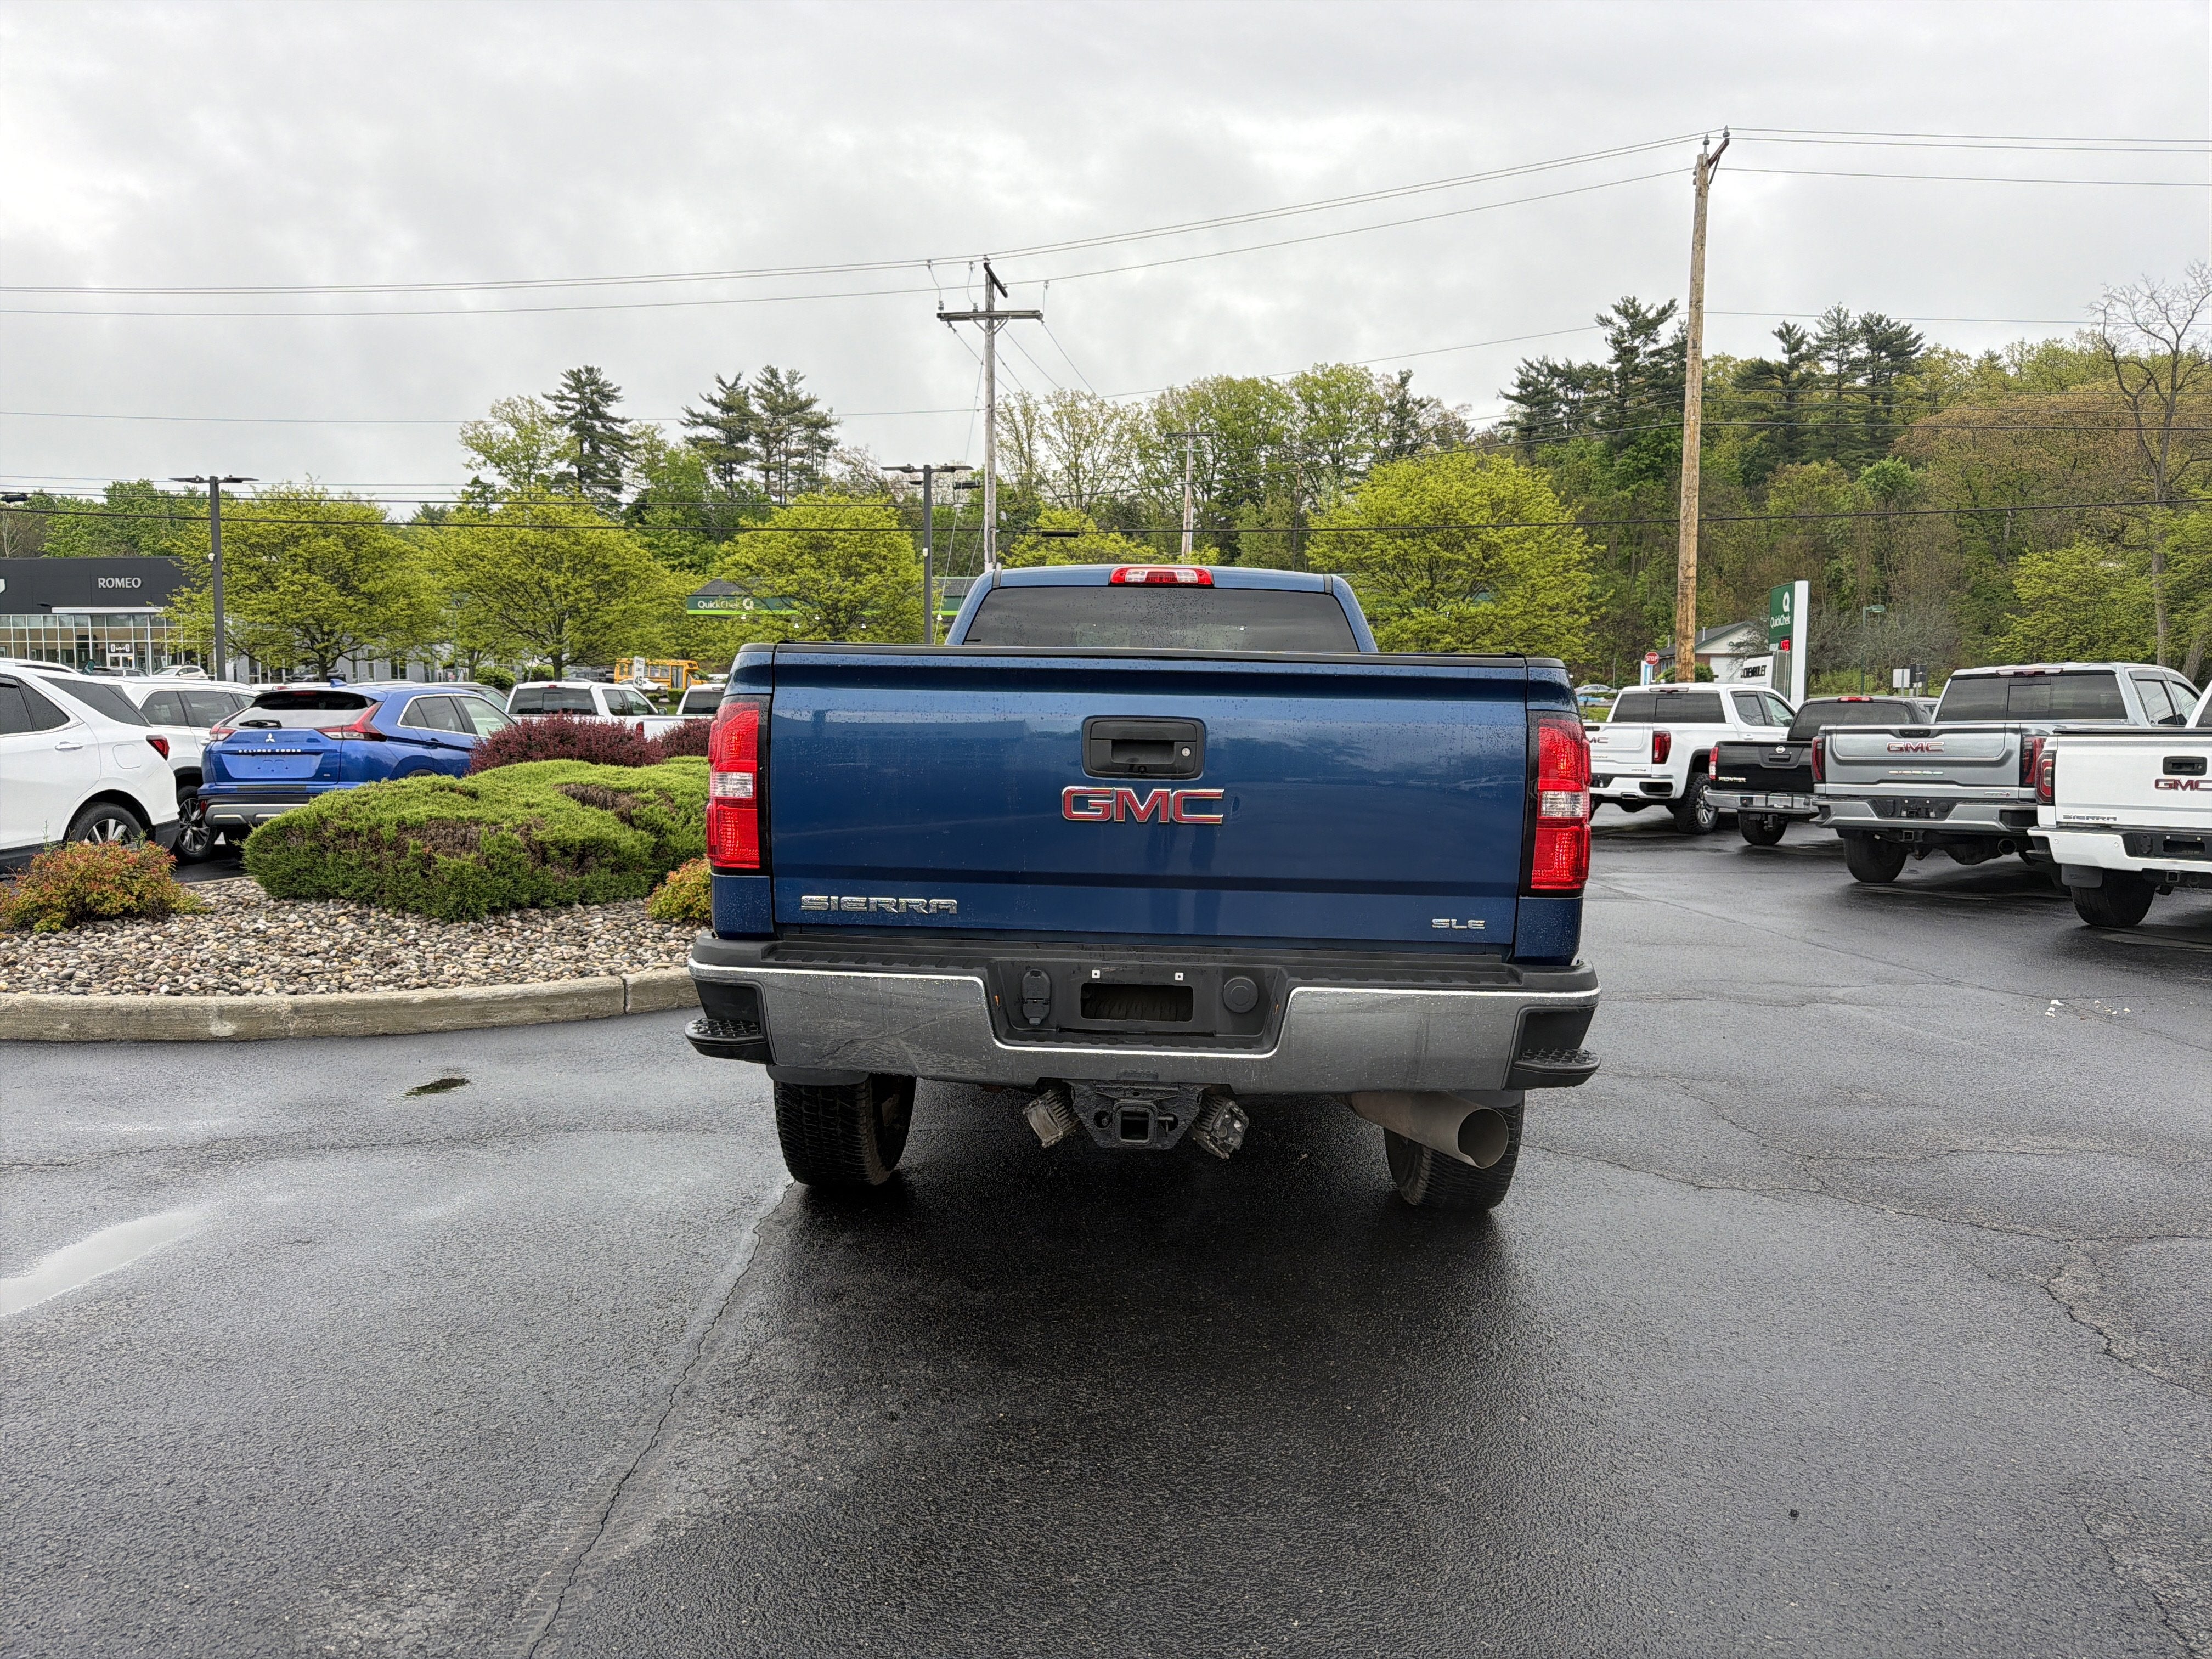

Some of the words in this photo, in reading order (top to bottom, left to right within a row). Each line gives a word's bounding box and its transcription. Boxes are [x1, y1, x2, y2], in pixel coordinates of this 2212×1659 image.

[98, 577, 142, 588] ROMEO
[1770, 613, 1791, 629] QuickChek
[1743, 665, 1767, 678] CHEVROLET
[634, 676, 642, 686] 45
[1886, 741, 1944, 753] GMC
[1062, 786, 1224, 824] GMC
[800, 895, 957, 914] SIERRA
[1432, 918, 1485, 930] SLE
